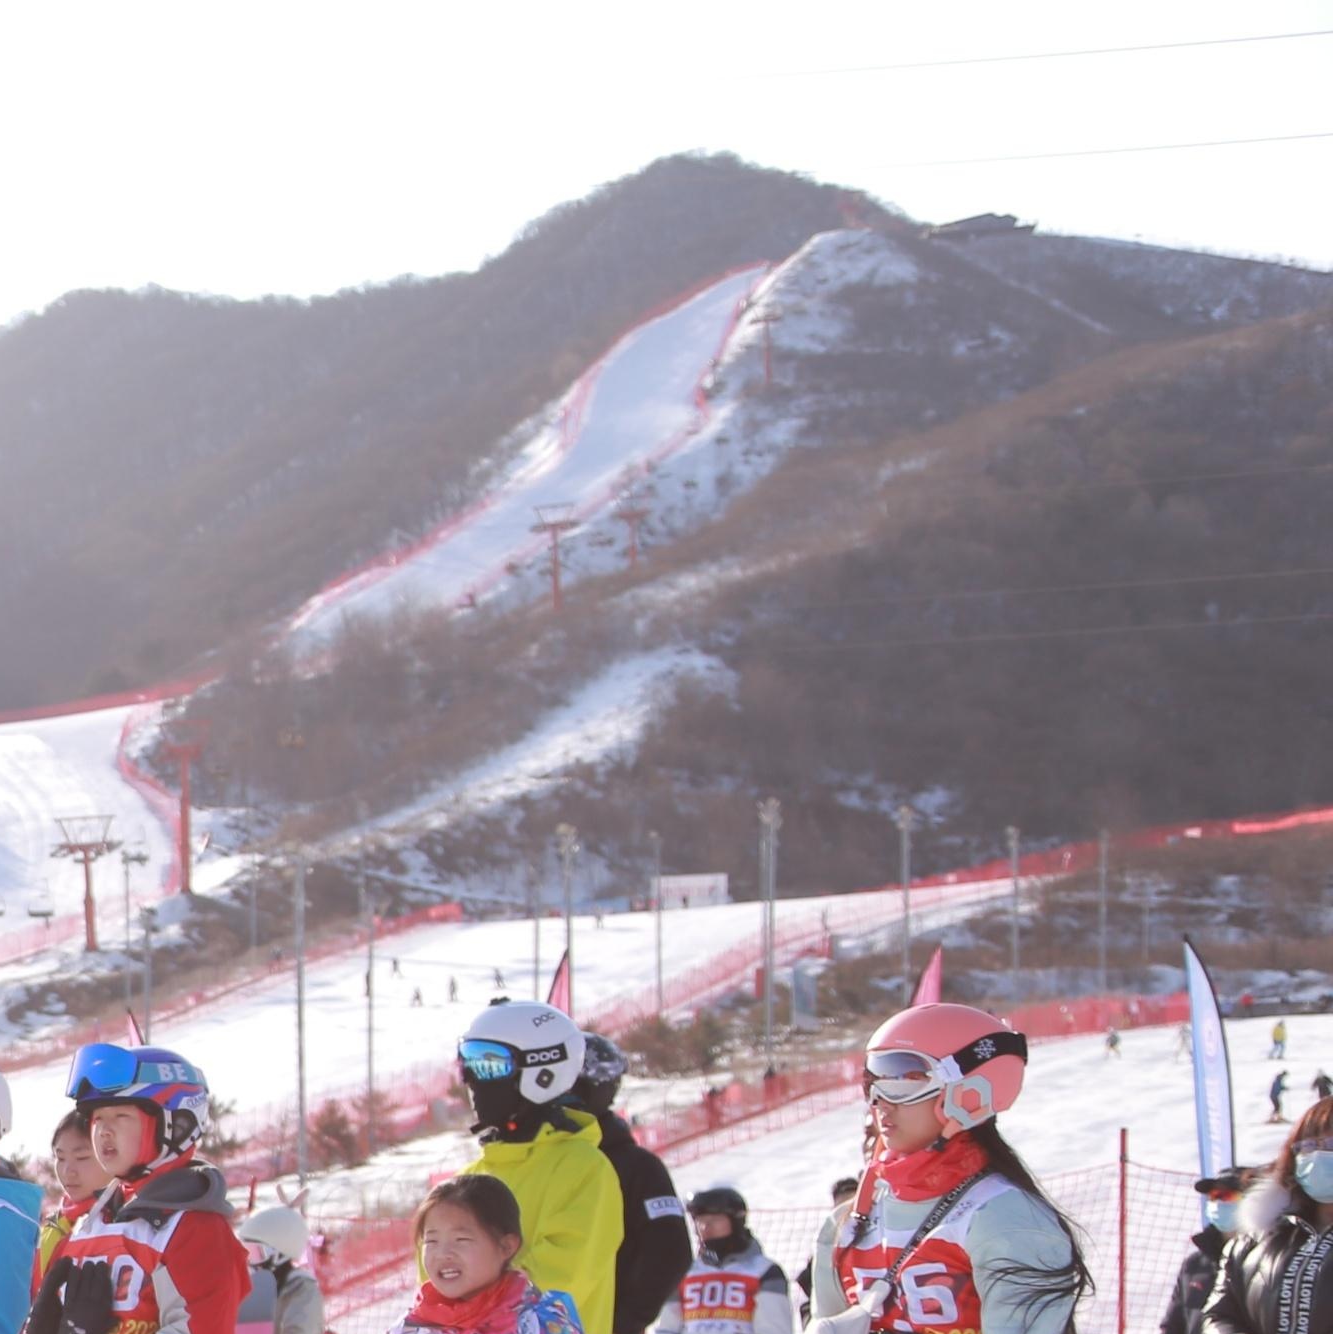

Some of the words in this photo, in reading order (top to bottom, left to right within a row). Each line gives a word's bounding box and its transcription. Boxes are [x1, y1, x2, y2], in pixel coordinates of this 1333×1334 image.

[1303, 1259, 1323, 1281] LOVE
[684, 1282, 746, 1309] 506
[852, 1263, 958, 1332] 56
[1279, 1278, 1294, 1304] LOVE
[1298, 1283, 1313, 1309] LOVE
[1277, 1306, 1291, 1333] LOVE
